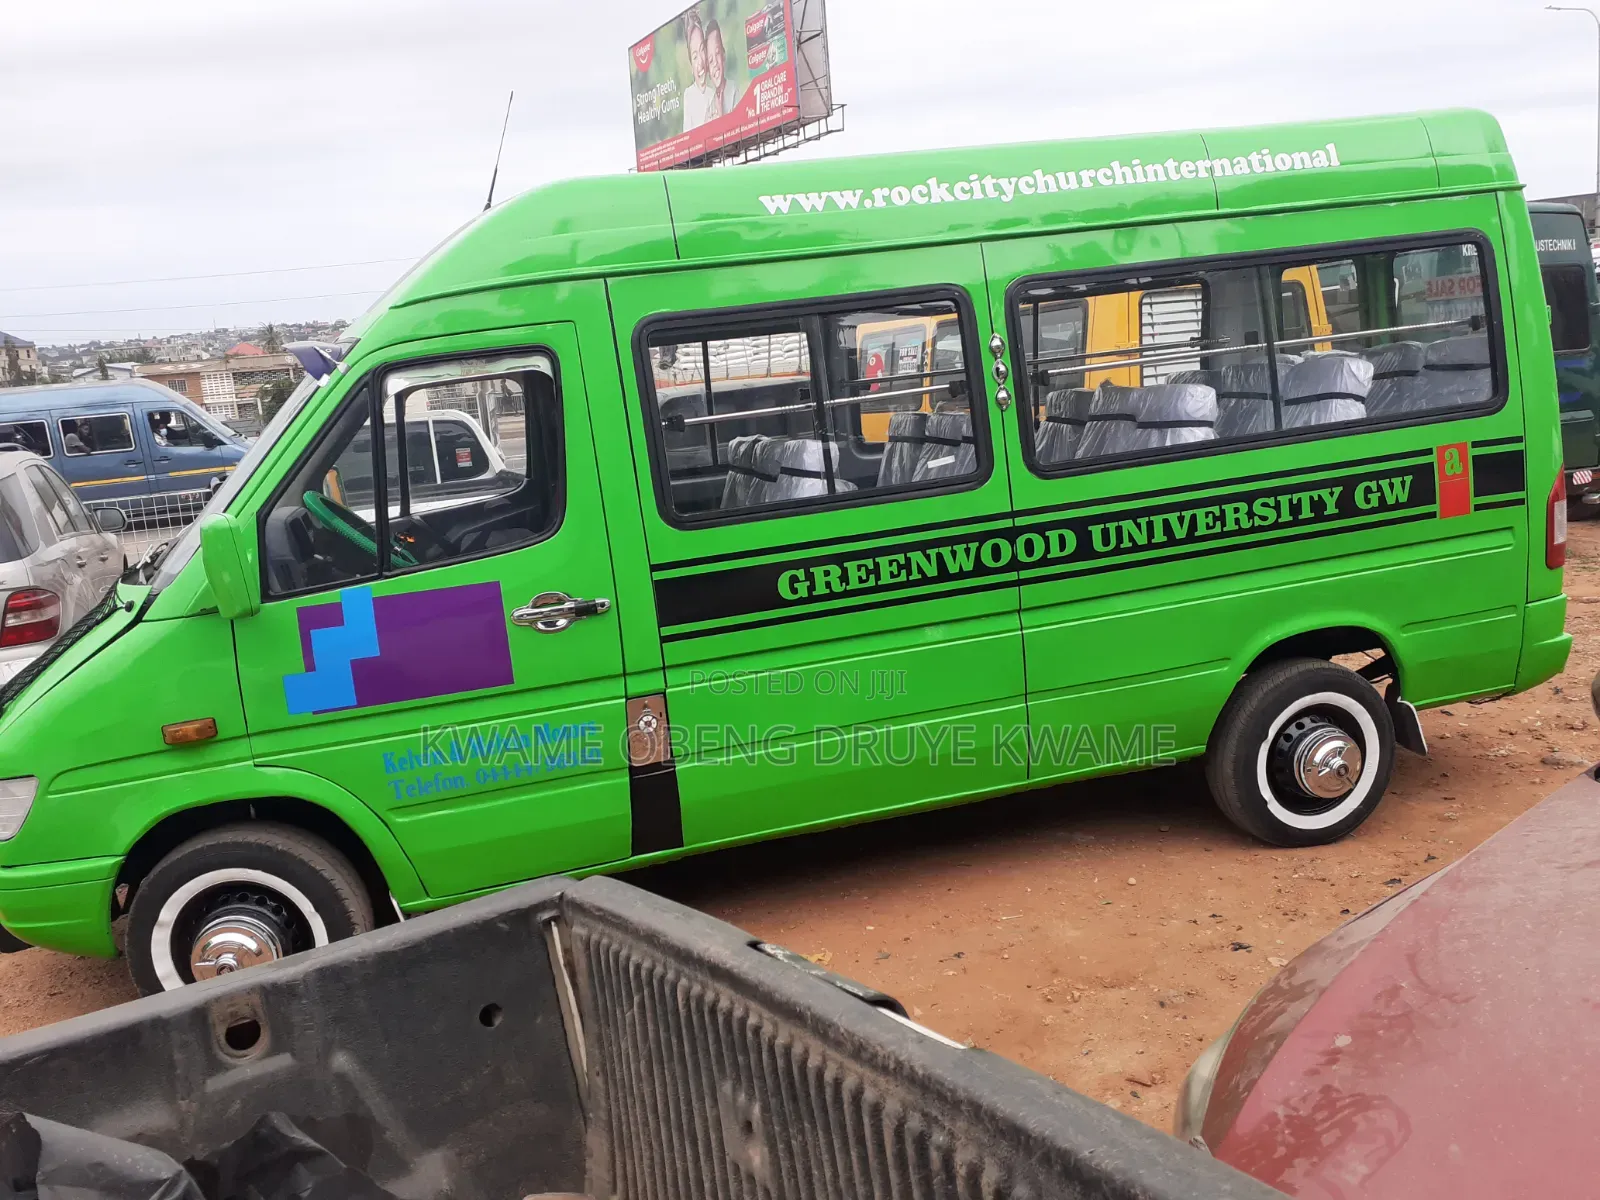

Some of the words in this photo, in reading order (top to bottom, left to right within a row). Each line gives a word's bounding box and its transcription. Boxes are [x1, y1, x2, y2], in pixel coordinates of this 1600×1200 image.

[747, 18, 765, 34] Colgate
[748, 48, 767, 64] Colgate
[760, 77, 774, 91] ORAL
[774, 71, 787, 86] CARE
[636, 88, 657, 107] Strong
[761, 102, 771, 113] THE
[637, 103, 661, 124] Healthy
[758, 142, 1340, 215] www.rockcitychurchinternational
[1445, 448, 1463, 476] a
[777, 528, 1077, 600] GREENWOOD
[1088, 486, 1343, 553] UNIVERSITY
[1354, 475, 1414, 509] GW
